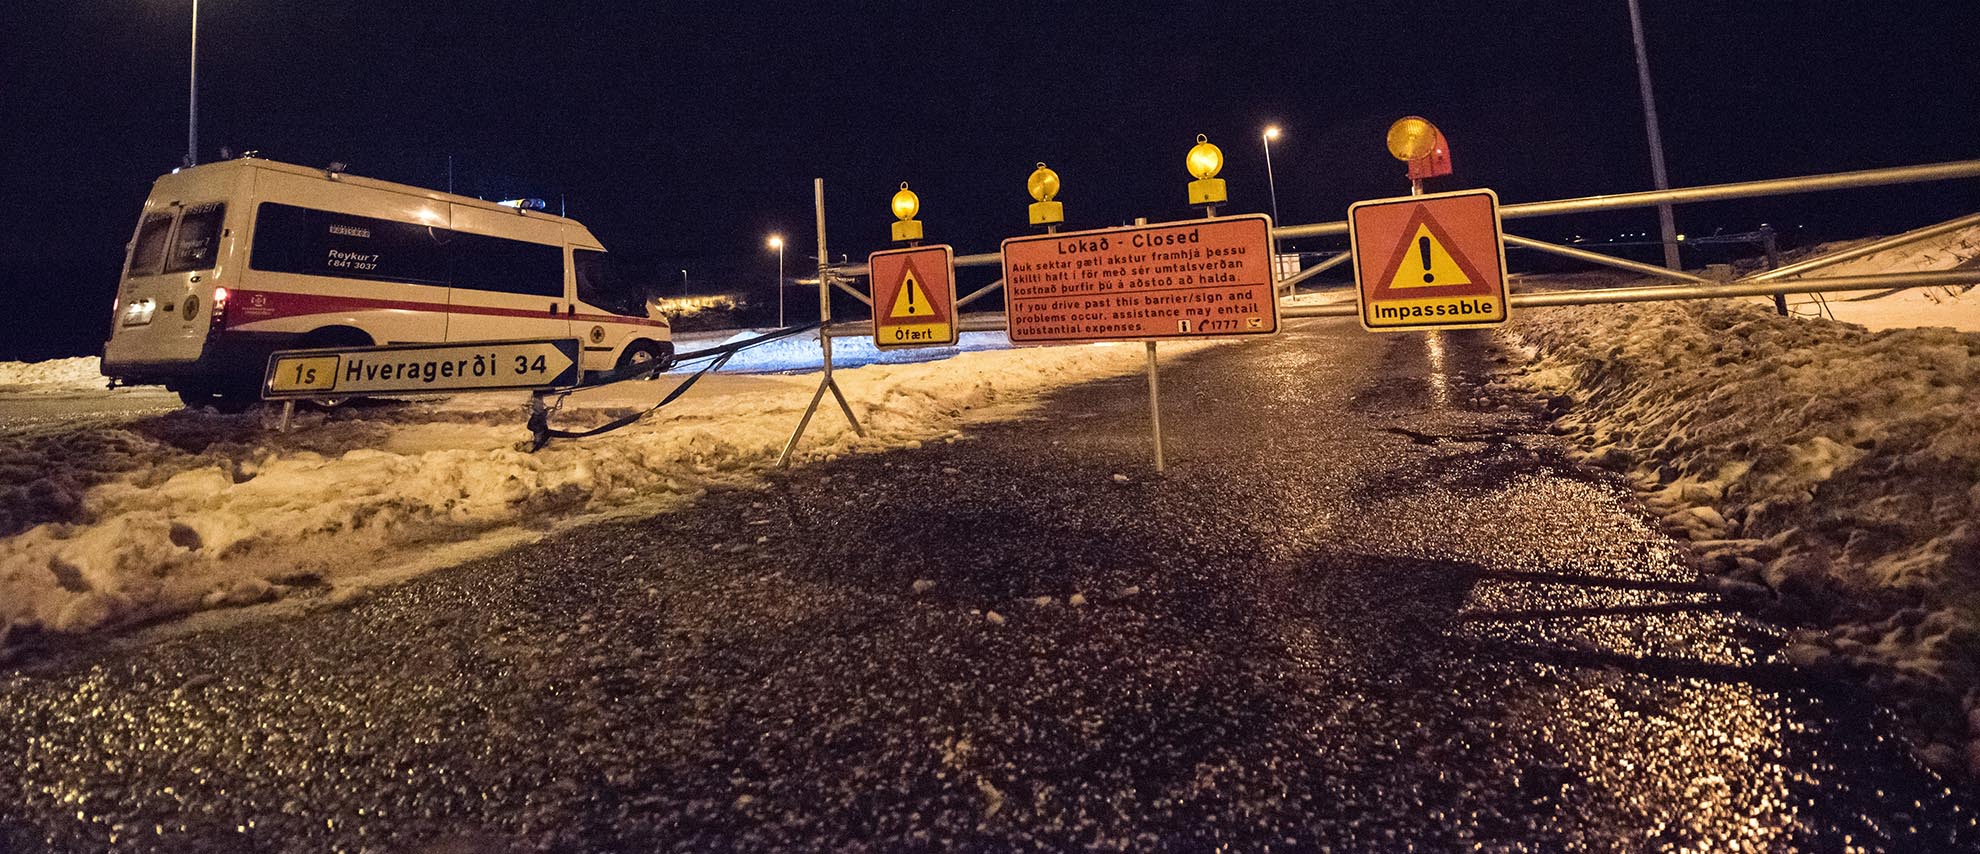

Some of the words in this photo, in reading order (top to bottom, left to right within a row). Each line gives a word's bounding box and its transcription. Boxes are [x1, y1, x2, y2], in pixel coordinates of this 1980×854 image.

[1058, 237, 1109, 255] Lokað
[1132, 228, 1199, 248] Closed
[328, 249, 370, 261] Reykur
[372, 254, 379, 262] 7
[333, 260, 351, 268] 841
[354, 262, 377, 270] 3037
[1012, 263, 1032, 273] Auk
[1036, 260, 1072, 270] sektar
[1076, 256, 1103, 269] gæti
[1107, 254, 1146, 265] akstur
[1152, 248, 1200, 261] framhjá
[1206, 246, 1246, 259] þessu
[1013, 273, 1040, 284] skilti
[1045, 271, 1068, 281] haft
[1081, 269, 1098, 279] för
[1103, 267, 1126, 277] með
[1131, 266, 1150, 275] sér
[1155, 260, 1243, 274] umtalsverðan
[1014, 285, 1057, 296] kostnað
[1061, 282, 1094, 294] þurfir
[1099, 280, 1113, 291] þú
[1118, 280, 1124, 289] á
[1129, 276, 1173, 288] aðstoð
[1179, 274, 1194, 285] að
[1199, 272, 1241, 284] halda.
[1015, 303, 1023, 312] If
[1028, 303, 1047, 313] you
[1052, 301, 1080, 310] drive
[1085, 298, 1111, 309] past
[1116, 297, 1140, 307] this
[1144, 293, 1223, 306] barrier/sign
[1228, 289, 1253, 300] and
[1375, 299, 1493, 321] Impassable
[1016, 313, 1066, 325] problems
[1112, 307, 1180, 319] assistance
[1186, 307, 1211, 317] may
[1217, 303, 1258, 314] entail
[895, 327, 932, 340] Ófært
[1017, 325, 1081, 336] substantial
[1085, 324, 1146, 334] expenses.
[1211, 320, 1239, 330] 1777
[294, 364, 316, 385] 1s
[345, 353, 497, 384] Hveragerði
[514, 354, 547, 376] 34
